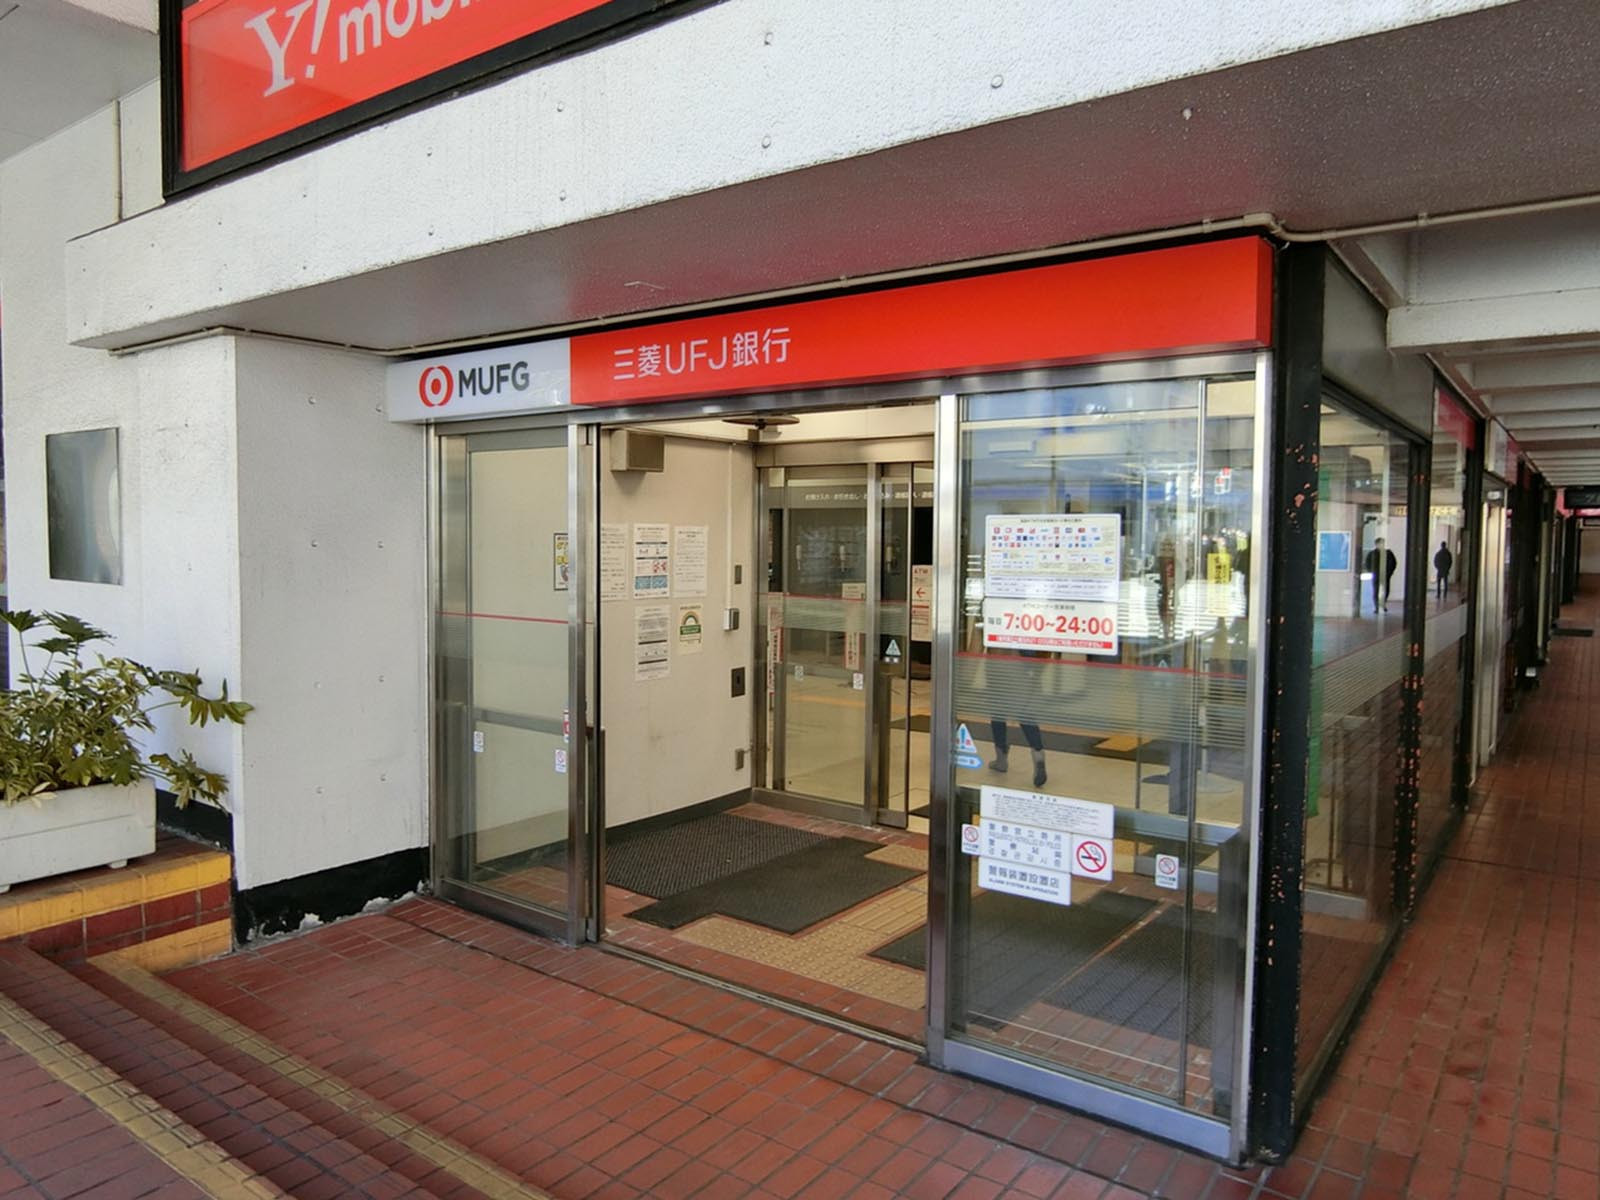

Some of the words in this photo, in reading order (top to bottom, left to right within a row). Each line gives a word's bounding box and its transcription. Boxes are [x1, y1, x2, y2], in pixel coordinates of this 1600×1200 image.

[613, 327, 791, 382] 三菱UFJ銀行
[458, 361, 530, 398] MUFG
